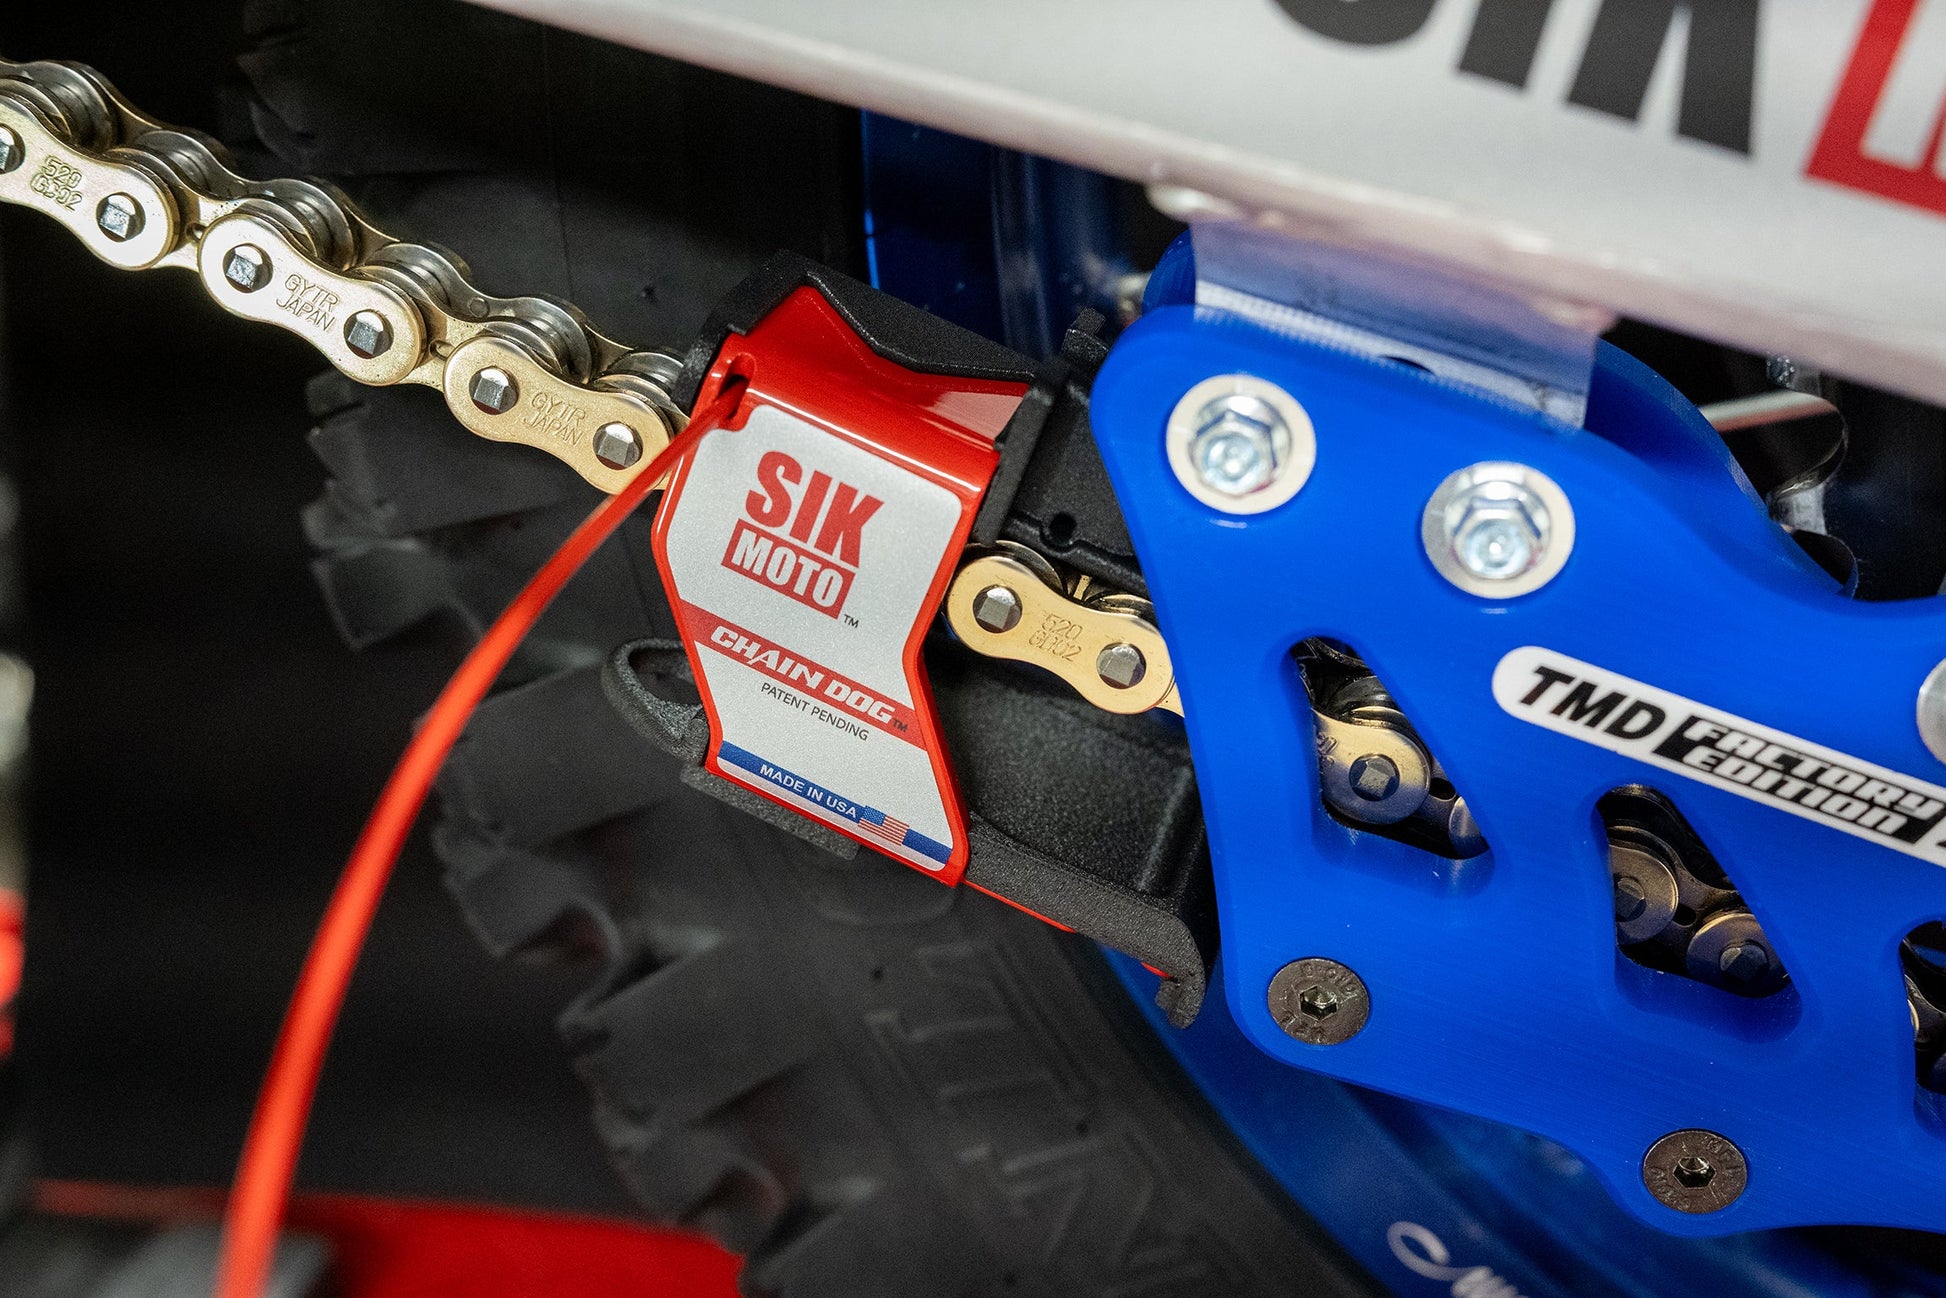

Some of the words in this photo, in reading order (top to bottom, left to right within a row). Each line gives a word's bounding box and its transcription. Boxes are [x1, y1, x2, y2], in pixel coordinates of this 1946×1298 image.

[41, 156, 83, 189] 520
[275, 293, 336, 331] JAPAN
[284, 272, 340, 313] GYTR
[522, 411, 585, 446] JAPAN
[531, 391, 586, 427] GYTR
[745, 451, 885, 568] SIK
[731, 528, 844, 608] MOTO
[1041, 612, 1083, 641] 520
[710, 625, 825, 690] CHAIN
[823, 679, 896, 724] DOG
[1520, 665, 1667, 740] TMD
[761, 682, 811, 712] PATENT
[810, 706, 870, 741] PENDING
[760, 764, 805, 792] MADE
[807, 786, 824, 802] IN
[826, 796, 858, 818] USA
[1682, 744, 1909, 835] EDITION
[1683, 716, 1946, 820] FACTORY
